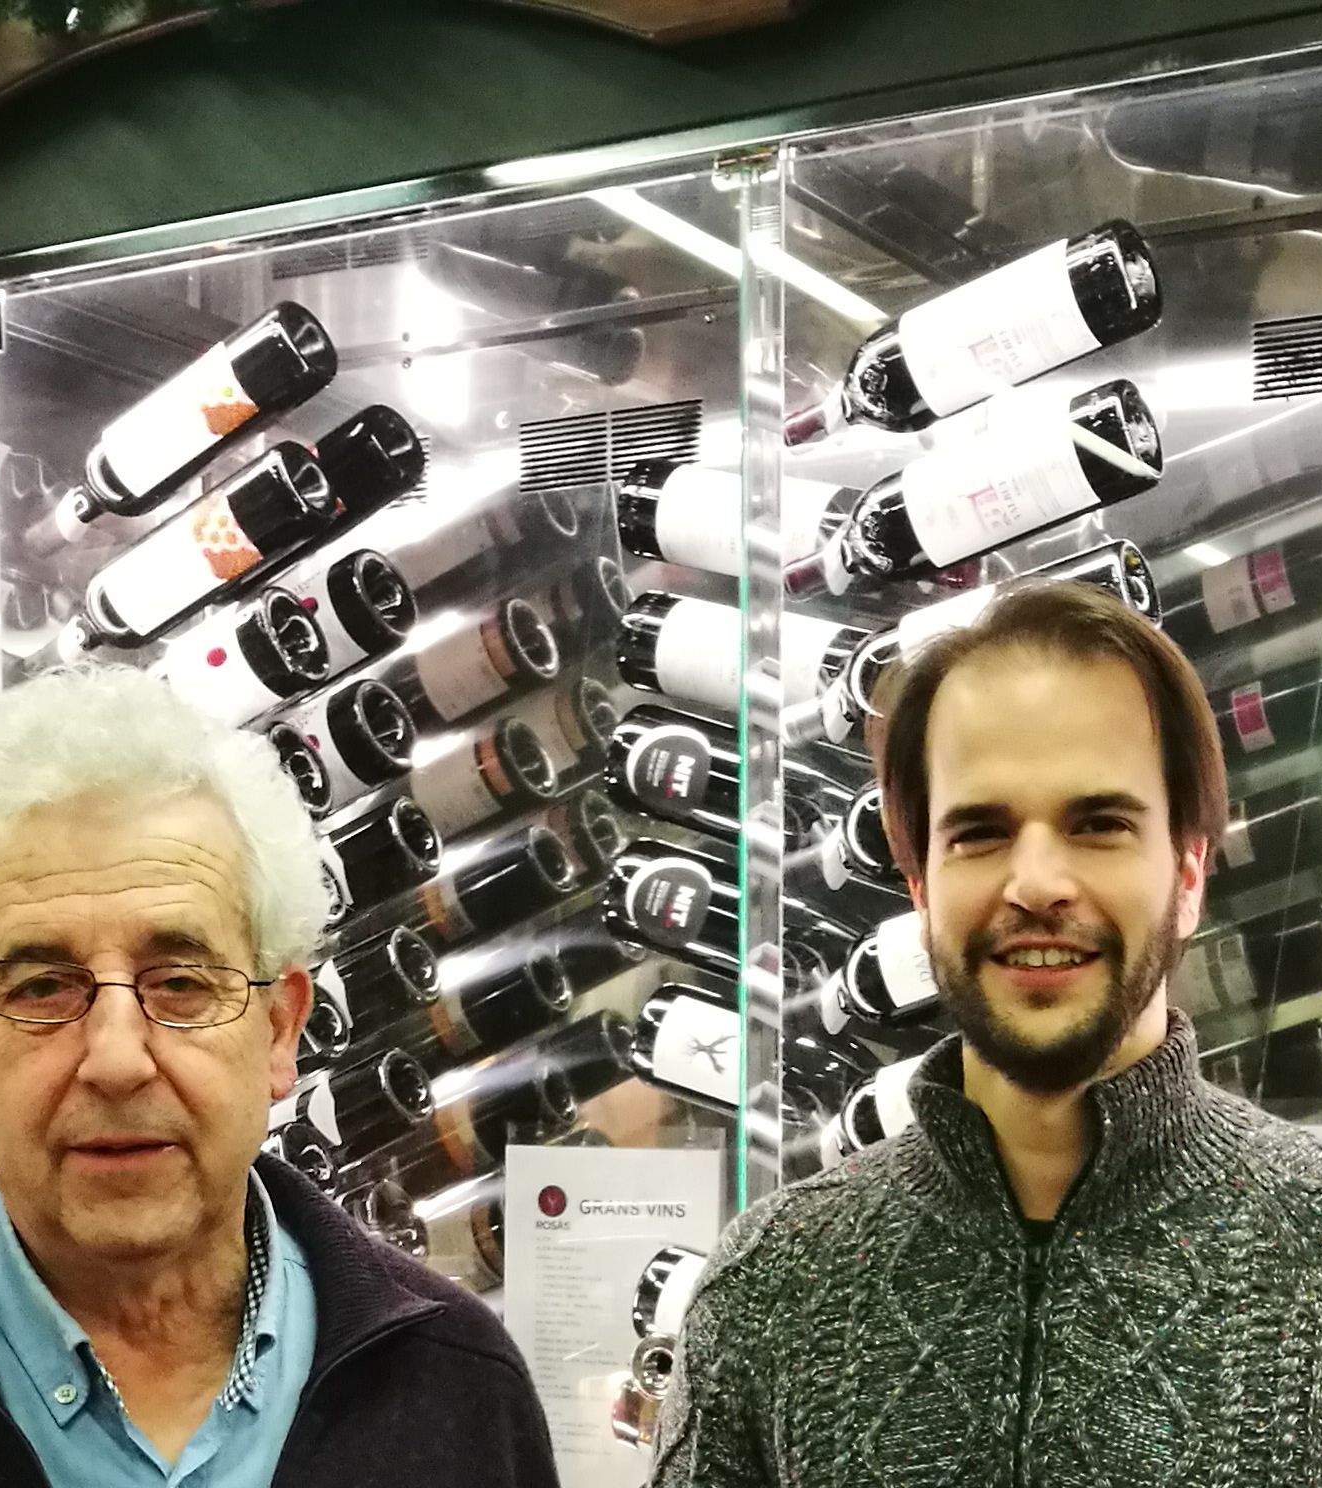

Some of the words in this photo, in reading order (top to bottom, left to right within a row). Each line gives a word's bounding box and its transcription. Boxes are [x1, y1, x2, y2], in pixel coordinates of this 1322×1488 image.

[671, 753, 697, 798] NIT
[669, 885, 697, 928] NIT
[579, 1200, 640, 1216] GRANS
[646, 1201, 687, 1218] VINS
